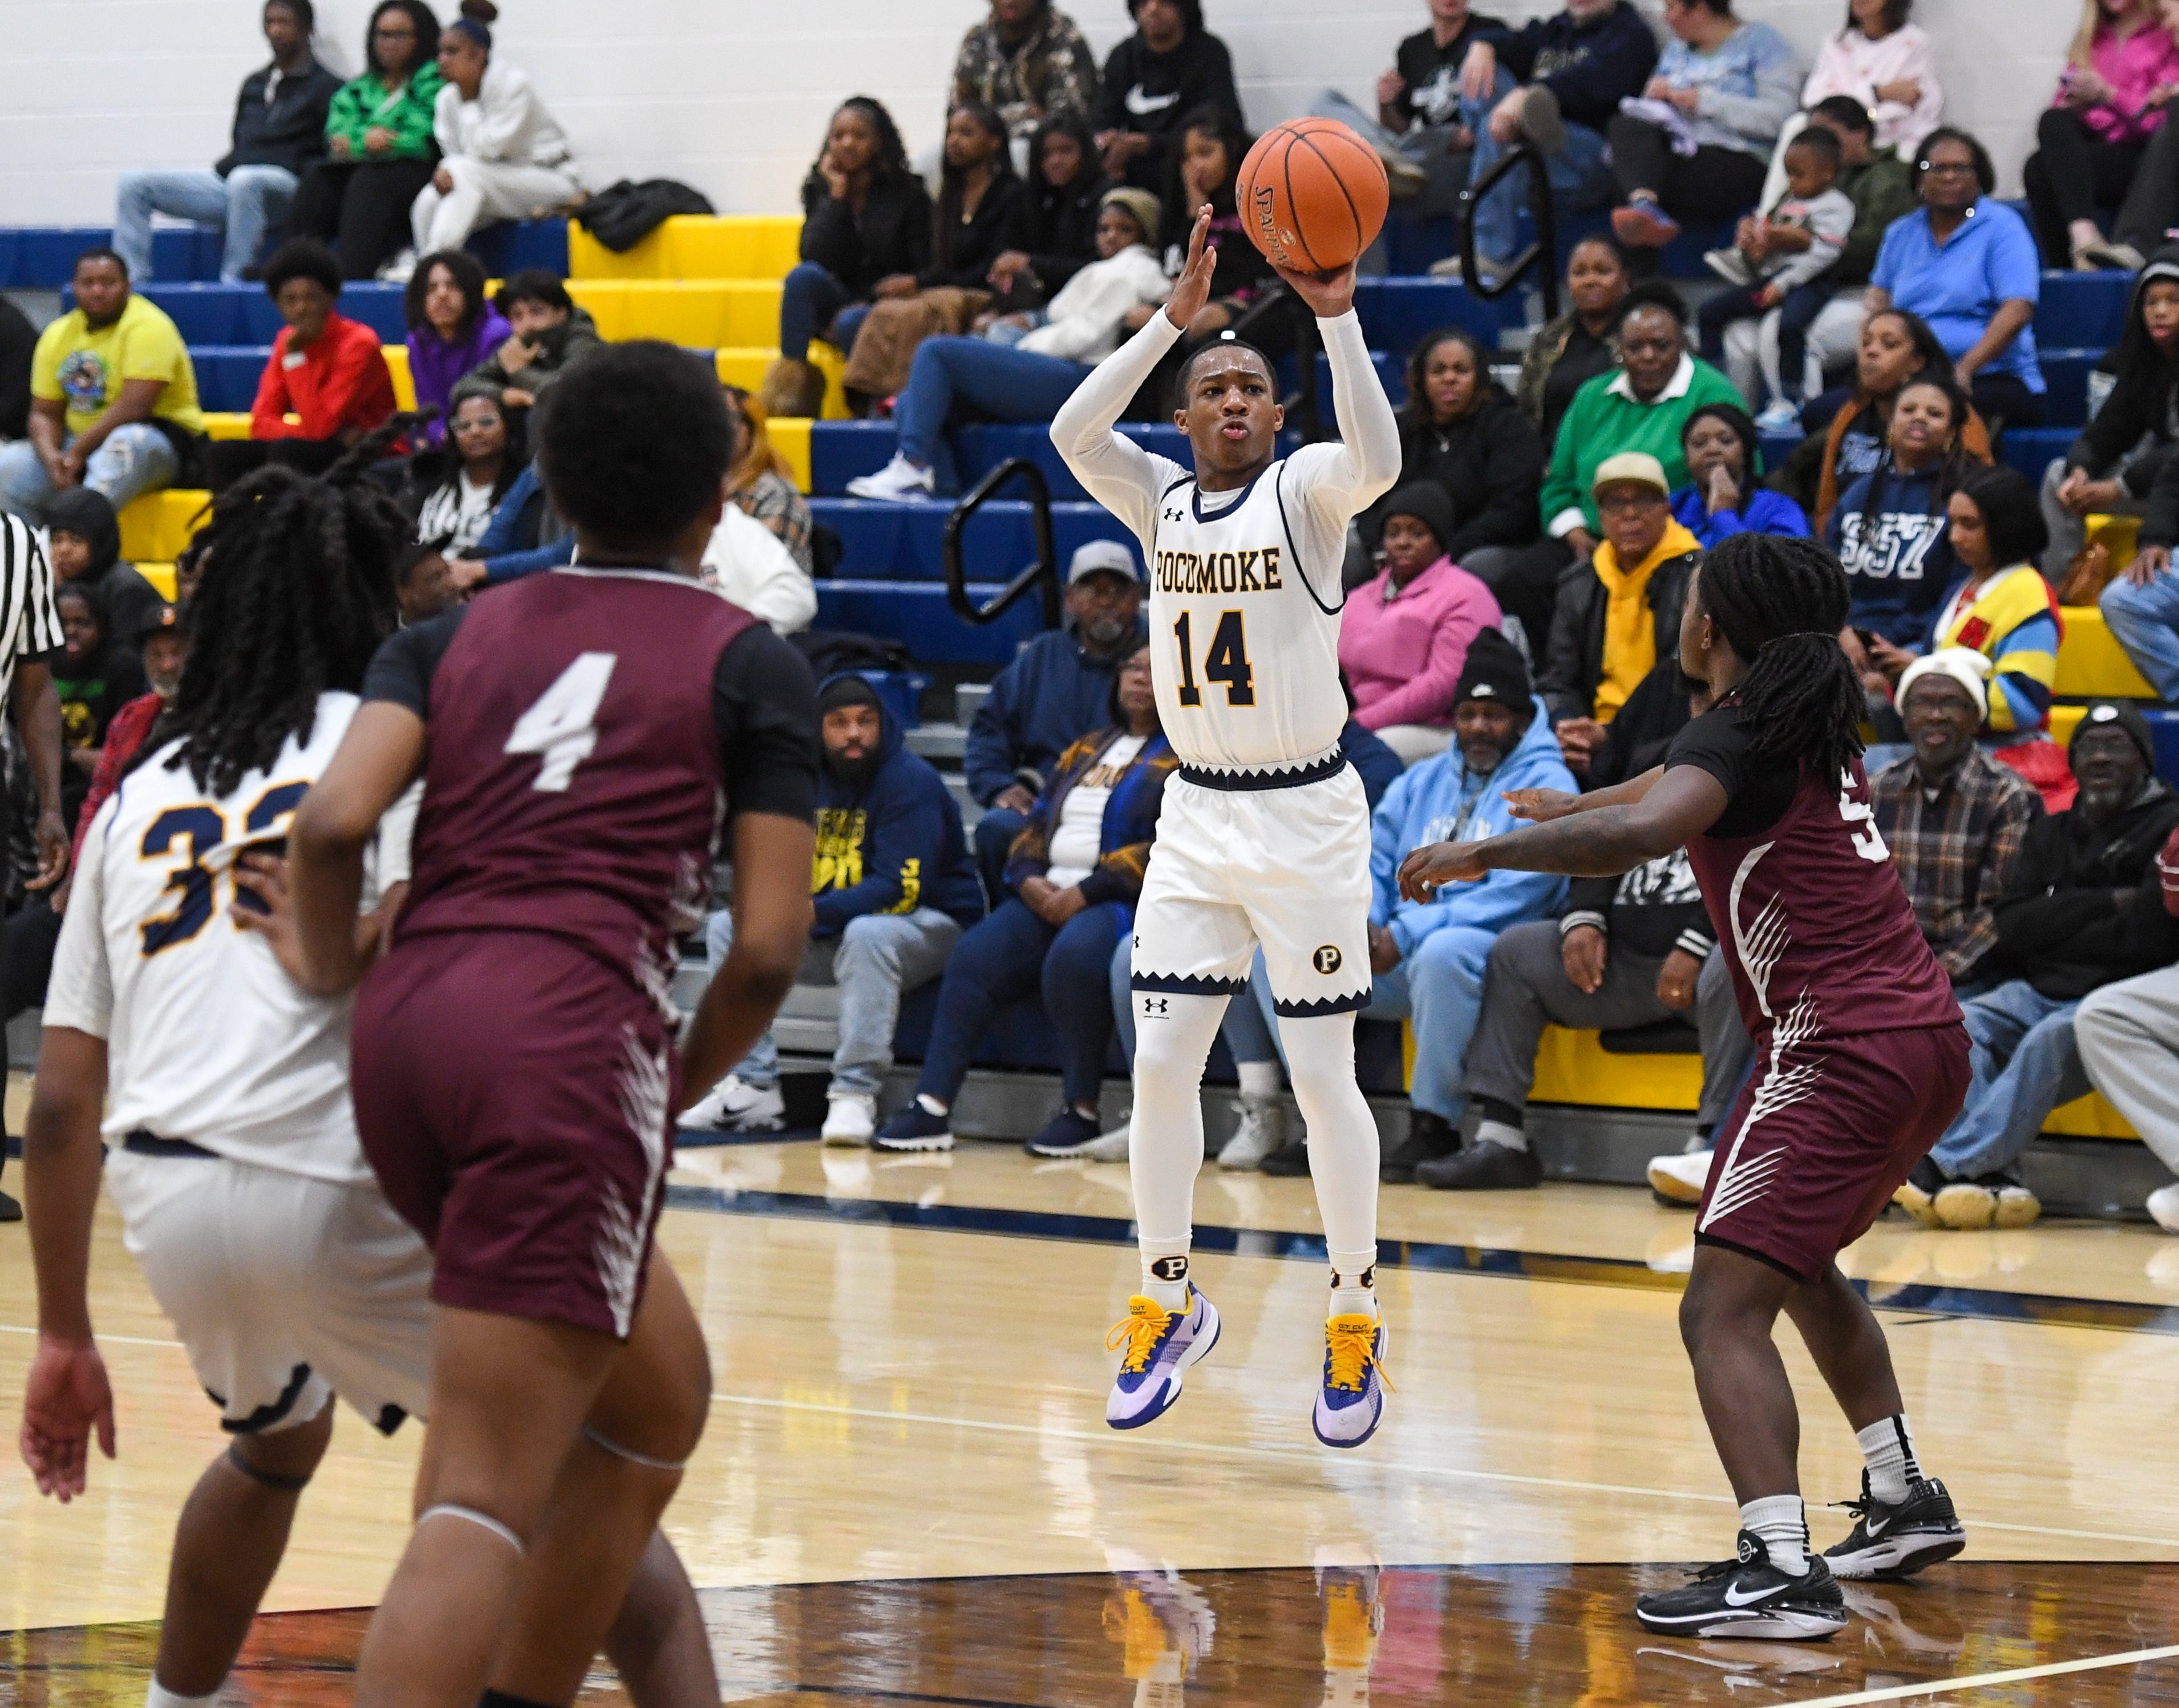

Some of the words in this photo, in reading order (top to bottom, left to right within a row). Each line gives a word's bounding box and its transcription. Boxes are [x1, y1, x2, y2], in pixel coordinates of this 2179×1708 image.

[1156, 547, 1282, 594] POCOMOKE
[1173, 609, 1256, 708] 14
[503, 651, 619, 792] 4
[1319, 948, 1339, 972] P
[1165, 1258, 1186, 1278] P
